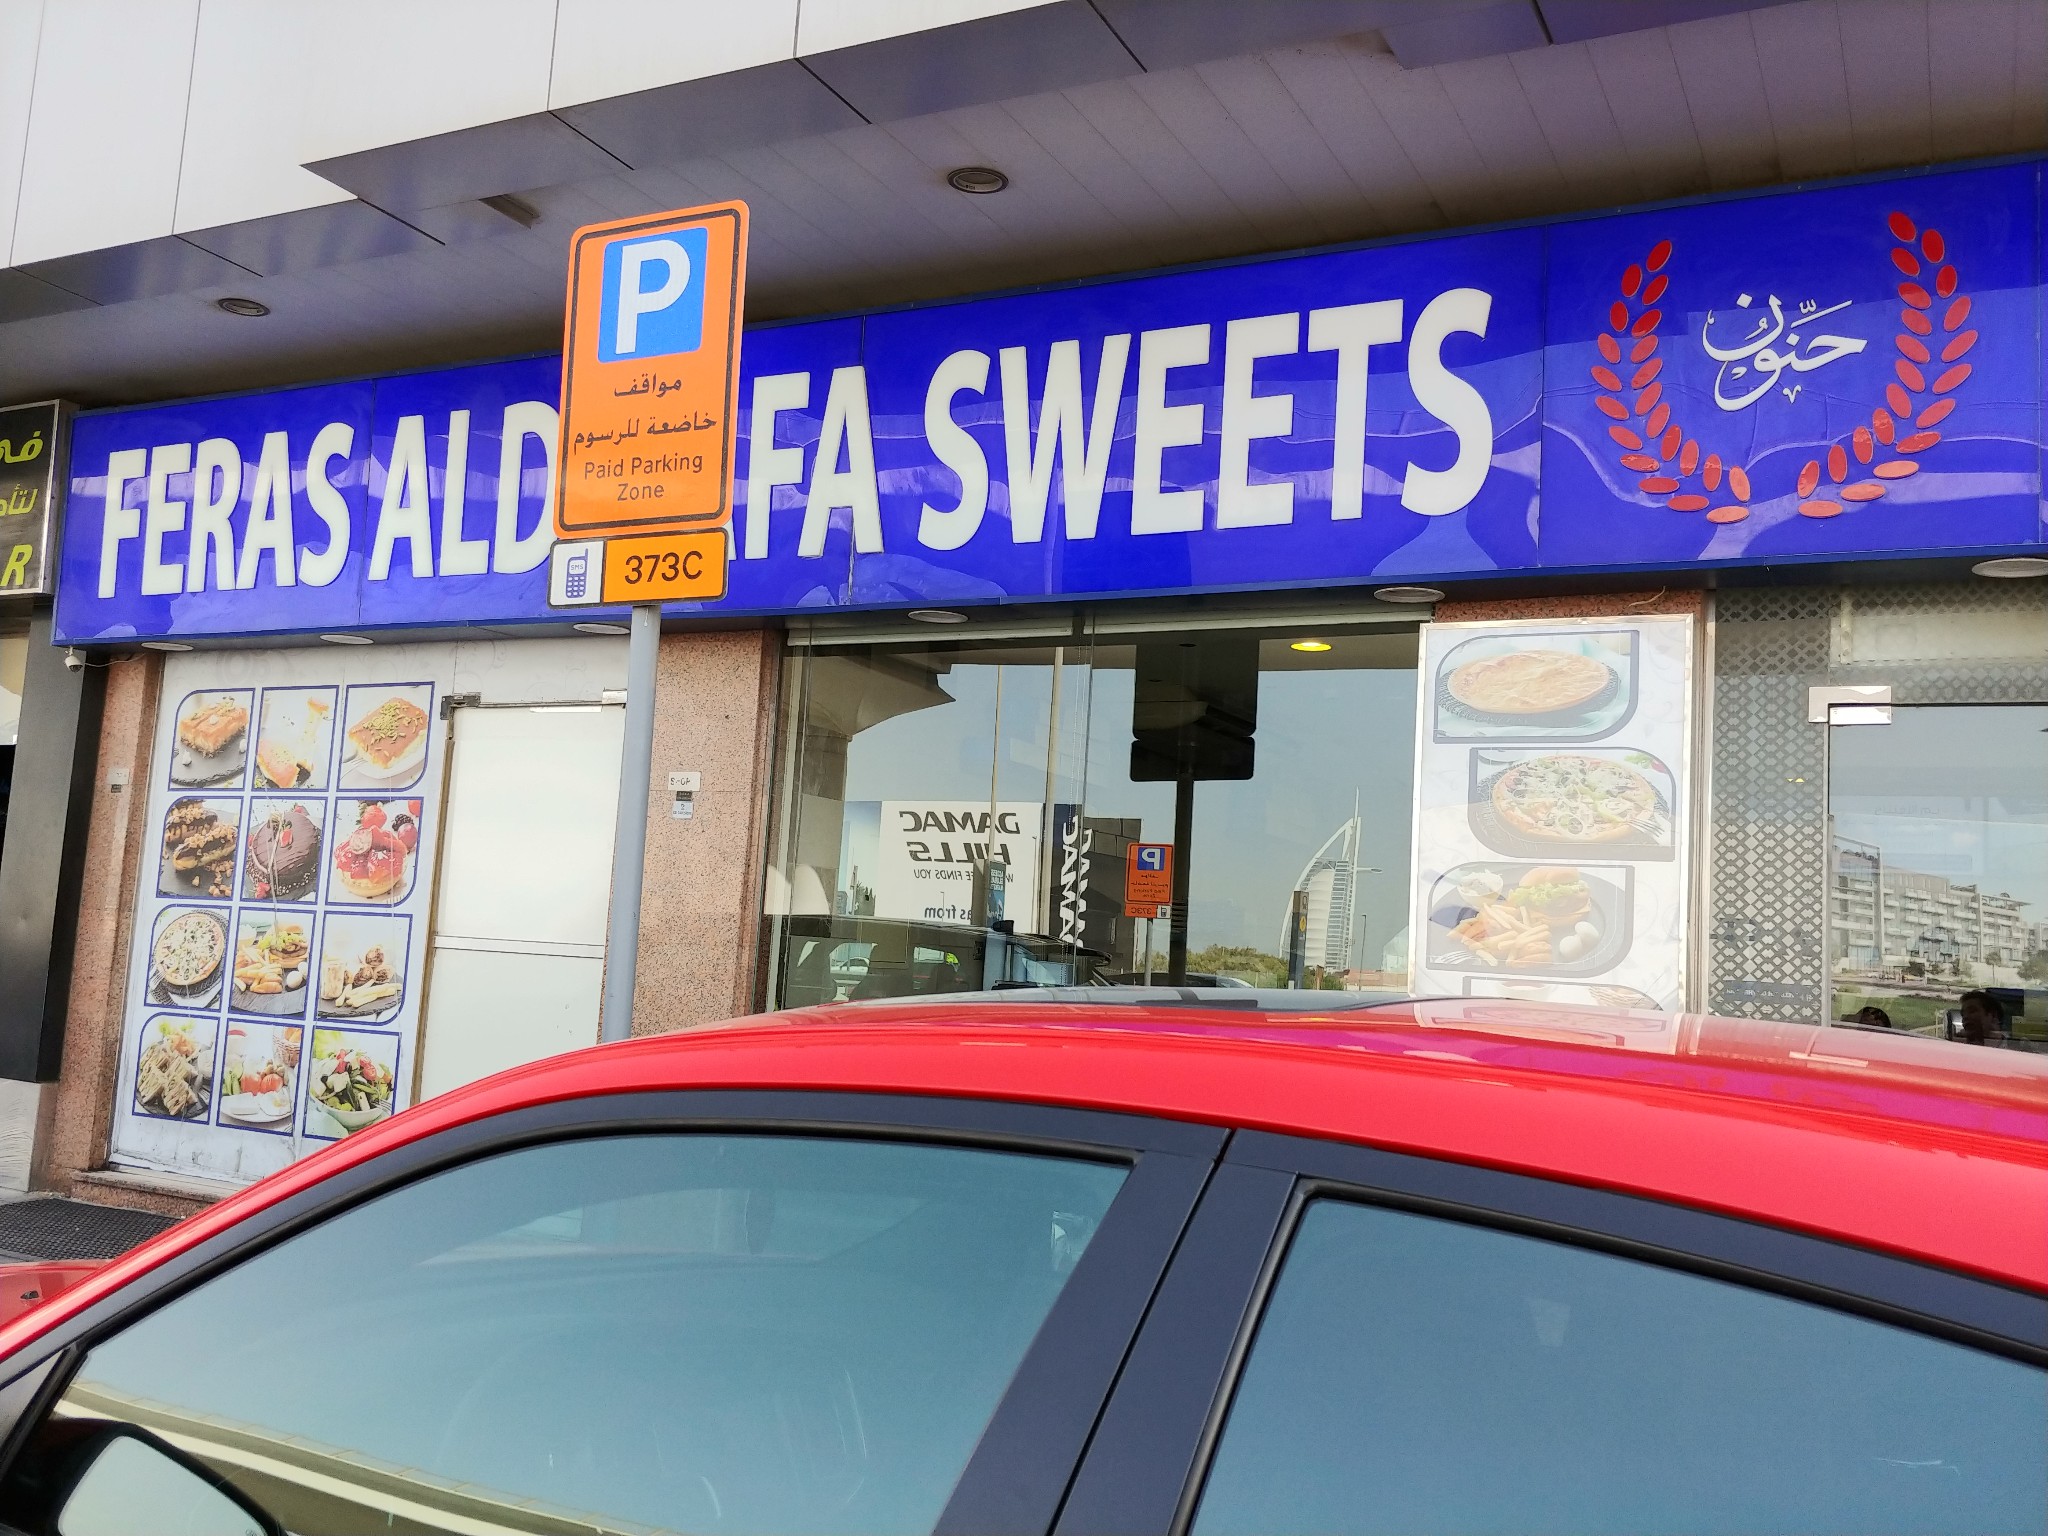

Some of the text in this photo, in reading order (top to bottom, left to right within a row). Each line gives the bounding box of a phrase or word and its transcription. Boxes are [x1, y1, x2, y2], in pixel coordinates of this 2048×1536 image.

[615, 239, 691, 355] P
[613, 373, 682, 397] مواقف
[97, 287, 1494, 600] FERAS ALDFA SWEETS
[573, 410, 717, 455] خاضعة للرسوم
[584, 452, 704, 481] Paid Parking
[617, 483, 665, 502] Zone
[570, 563, 584, 571] SMS
[624, 551, 703, 584] 373C
